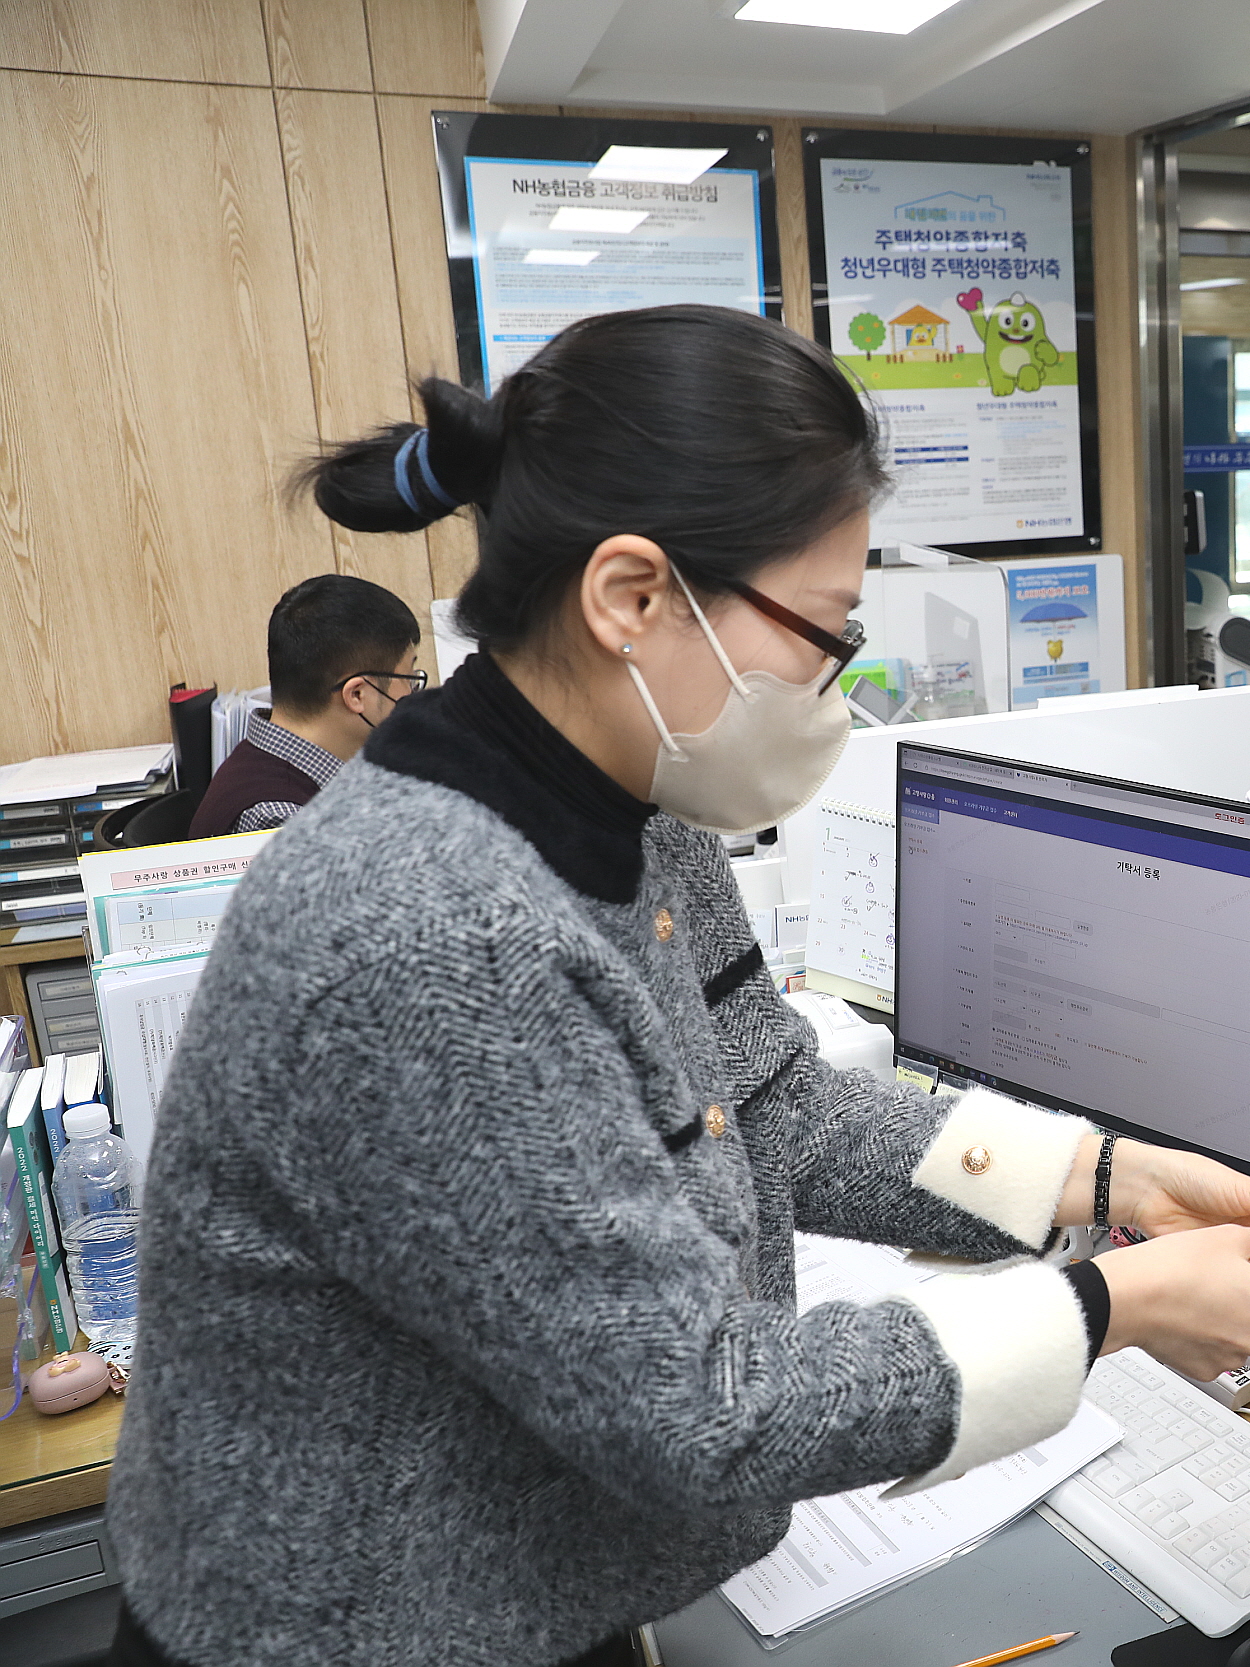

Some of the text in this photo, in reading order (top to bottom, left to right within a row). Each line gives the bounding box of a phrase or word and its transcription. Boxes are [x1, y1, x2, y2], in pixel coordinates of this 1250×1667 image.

[512, 179, 718, 203] NH농협금융 고객정보 취급방침
[875, 229, 1027, 251] 주택청약종합저축
[841, 256, 1060, 280] 청년우대형 주택청약종합저축
[134, 870, 169, 883] 무주사랑
[173, 867, 198, 879] 상품권
[202, 863, 237, 875] 할인구매
[1117, 860, 1161, 881] 기탁서 등록
[50, 1128, 60, 1153] 2022
[16, 1146, 28, 1172] 2022
[1129, 1582, 1139, 1591] AND
[1137, 1589, 1166, 1613] INTELLIGENCE
